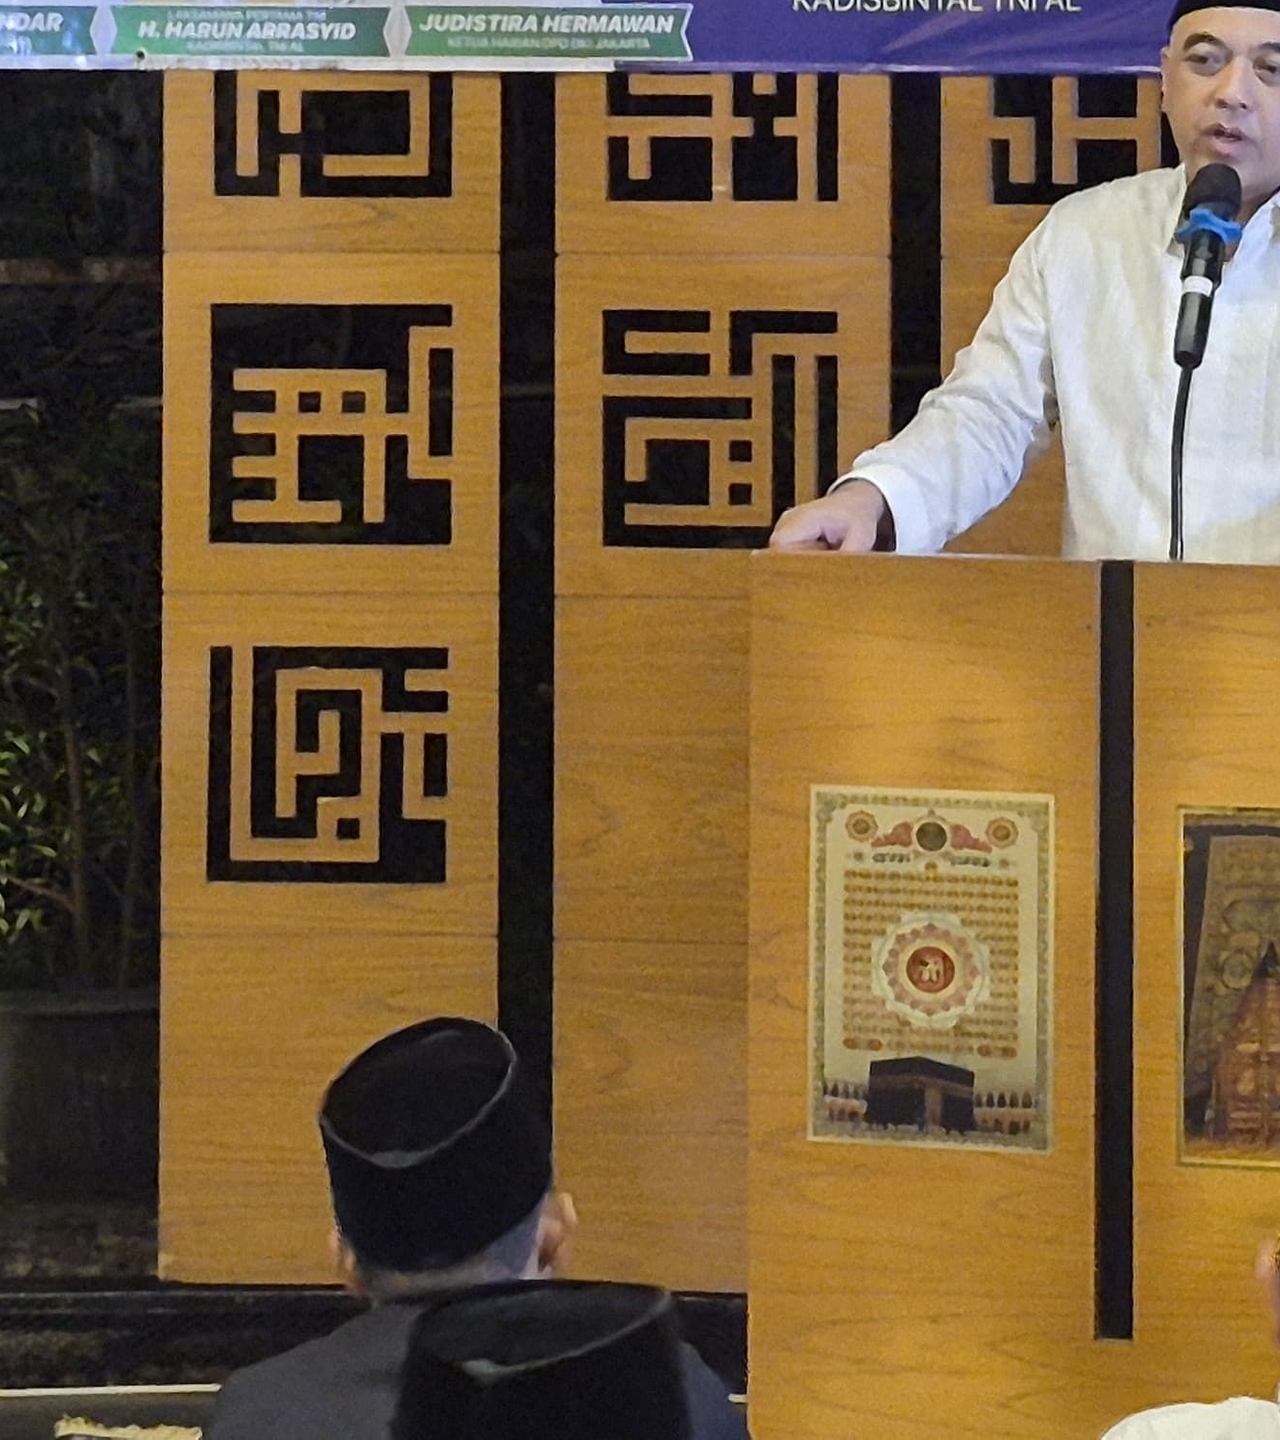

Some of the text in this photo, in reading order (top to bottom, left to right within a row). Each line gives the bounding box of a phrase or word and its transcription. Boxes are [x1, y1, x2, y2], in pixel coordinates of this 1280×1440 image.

[164, 20, 244, 41] HARUN
[419, 13, 674, 34] JUDISTIRA HERMAWAN
